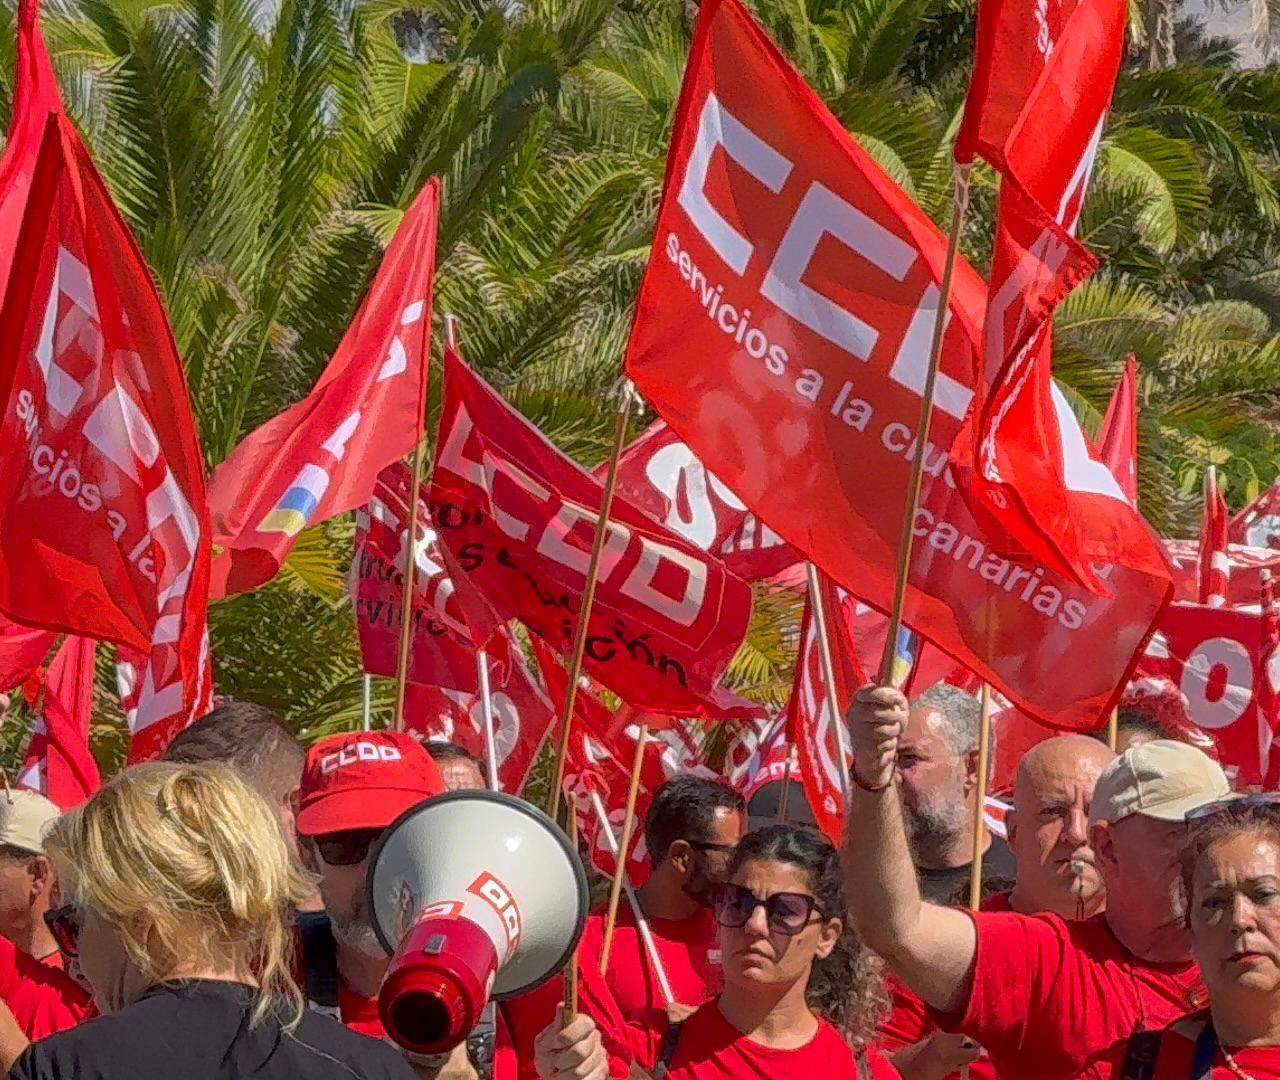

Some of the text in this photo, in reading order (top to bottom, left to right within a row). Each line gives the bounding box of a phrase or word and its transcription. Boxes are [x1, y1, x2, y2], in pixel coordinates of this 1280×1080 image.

[666, 232, 789, 376] servicios
[795, 368, 824, 402] a
[831, 380, 873, 433] la
[911, 507, 1088, 629] canarias
